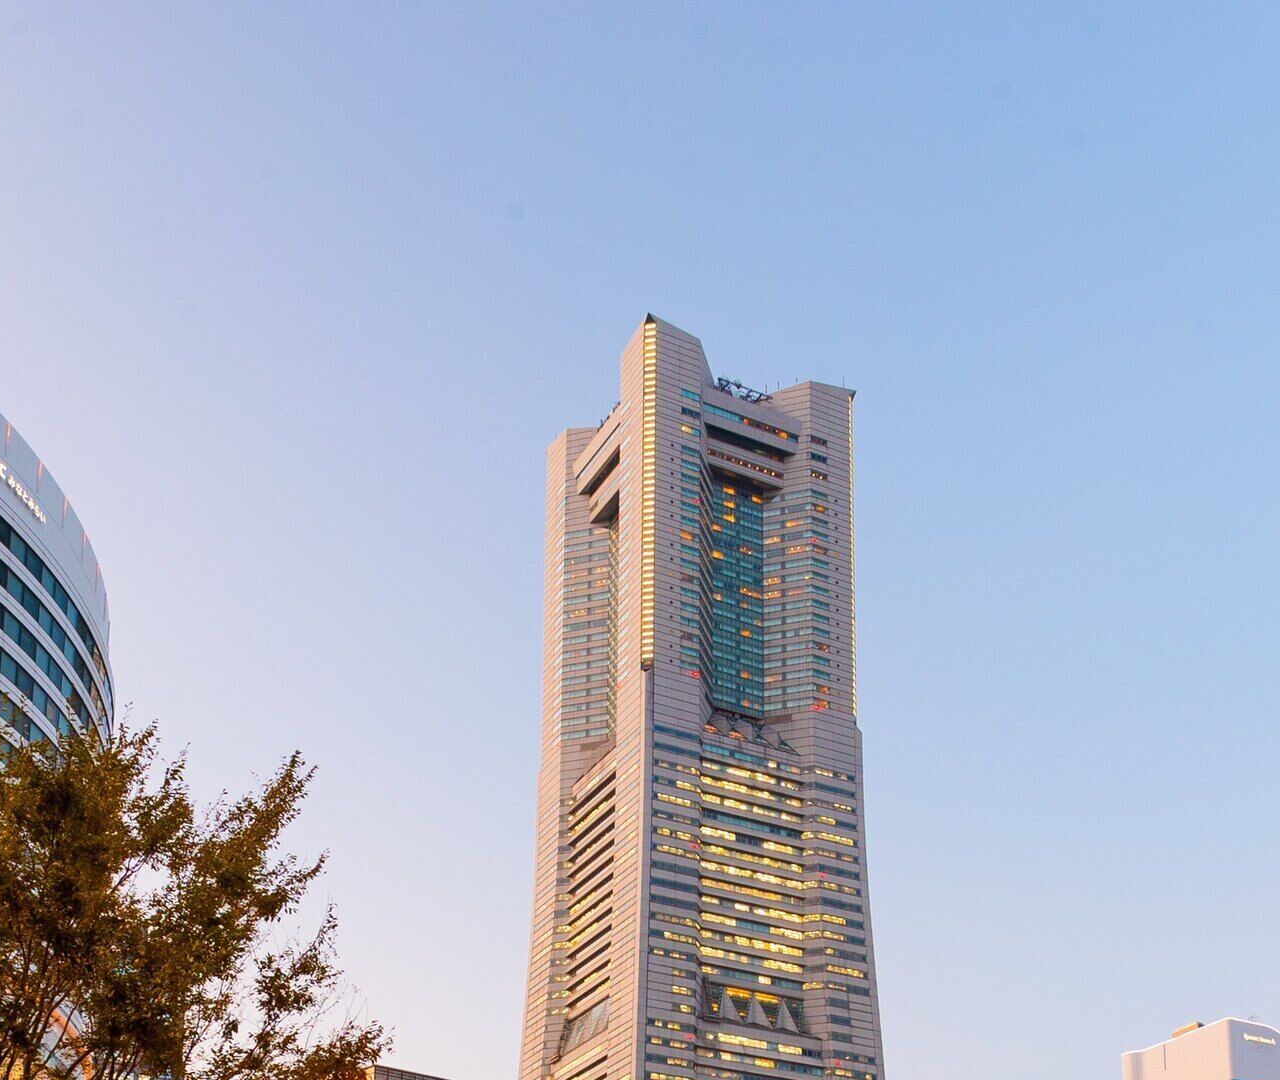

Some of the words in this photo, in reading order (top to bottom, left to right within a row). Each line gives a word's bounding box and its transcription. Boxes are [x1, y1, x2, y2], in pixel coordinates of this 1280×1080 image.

[7, 475, 46, 524] みなとみらい
